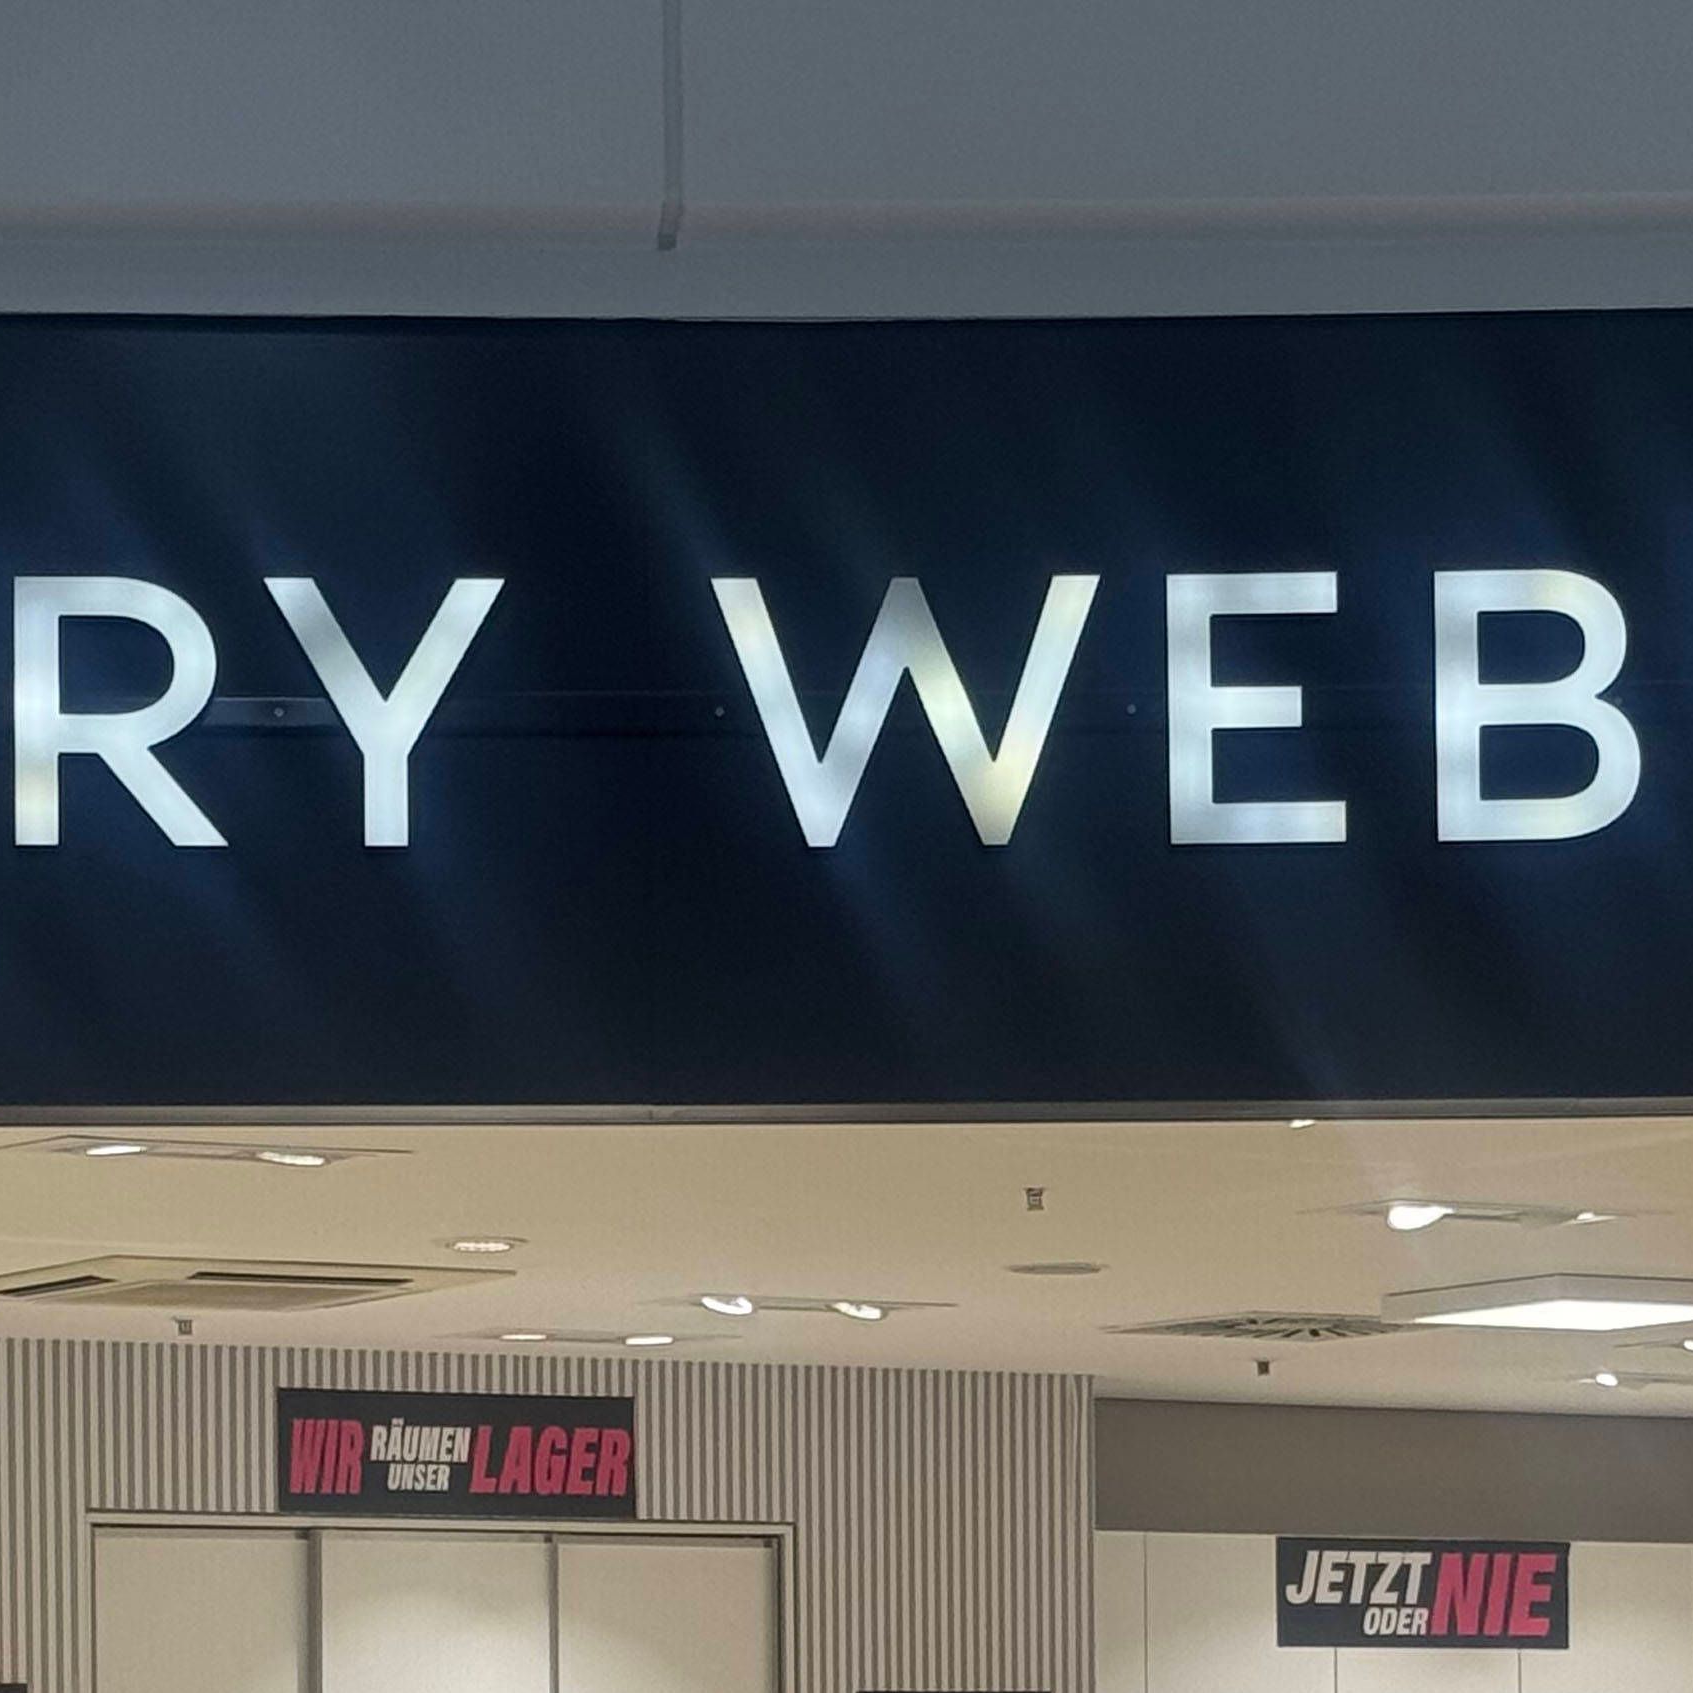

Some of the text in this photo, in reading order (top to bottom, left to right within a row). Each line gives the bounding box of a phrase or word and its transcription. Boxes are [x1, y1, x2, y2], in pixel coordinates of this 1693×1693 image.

[289, 1417, 634, 1498] WIR RÄUMEN UNSER LAGER
[1285, 1549, 1557, 1639] JETZT ODER NIE
